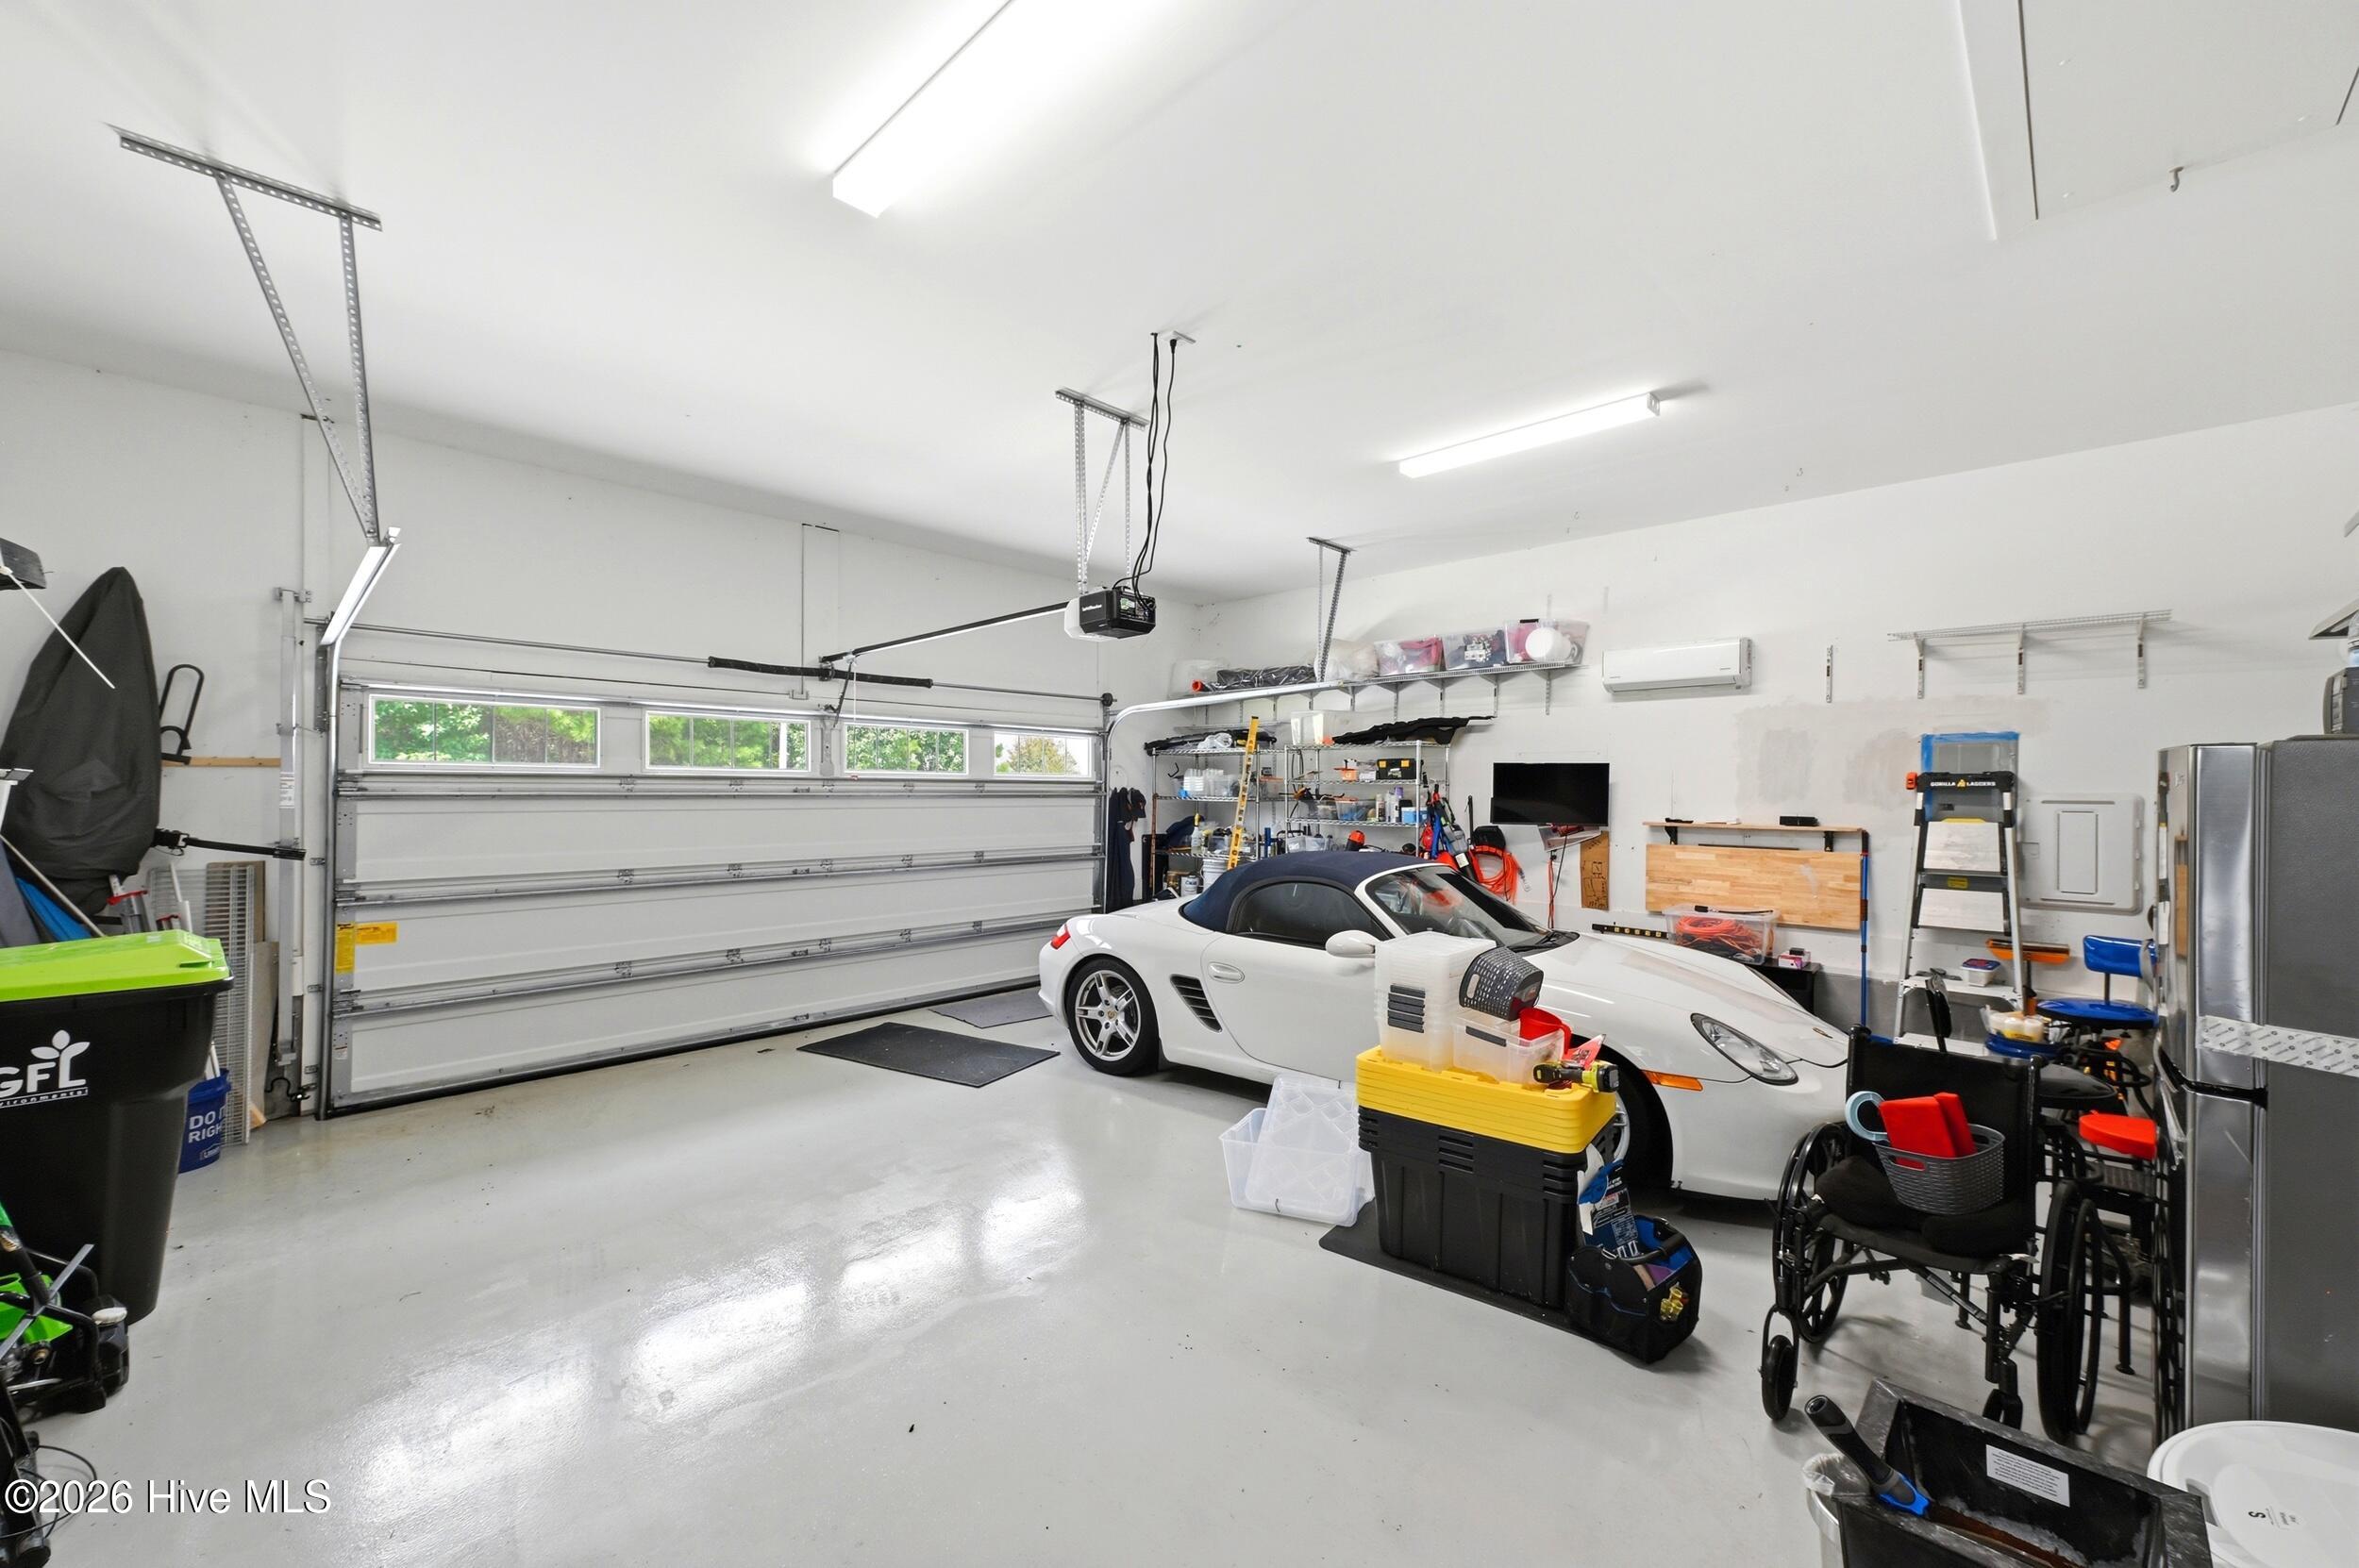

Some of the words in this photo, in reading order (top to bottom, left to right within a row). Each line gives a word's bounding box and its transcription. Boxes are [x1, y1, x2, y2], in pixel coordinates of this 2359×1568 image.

[0, 1042, 91, 1098] GFL
[189, 1110, 216, 1129] DO
[188, 1123, 223, 1143] RIGH
